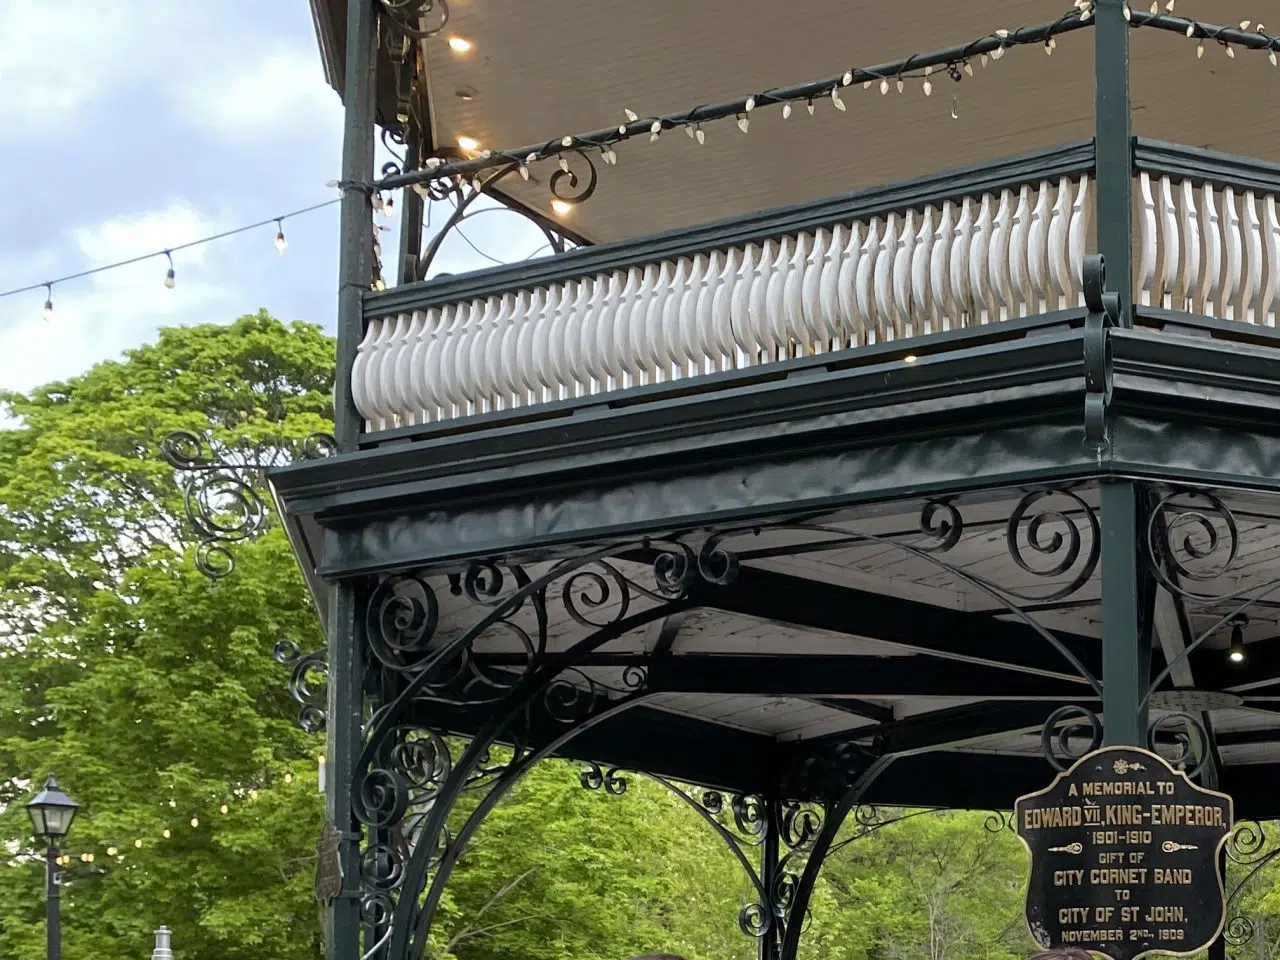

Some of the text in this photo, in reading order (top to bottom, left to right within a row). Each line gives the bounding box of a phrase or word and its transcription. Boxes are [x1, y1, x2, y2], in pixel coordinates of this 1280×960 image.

[1068, 781, 1175, 797] A MEMORIAL TO
[1024, 806, 1082, 830] EDWARD
[1092, 830, 1152, 845] 1901-1910
[1098, 852, 1145, 864] GIFT OF
[1053, 868, 1192, 887] CITY CORNET BAND
[1114, 889, 1131, 901] TO
[1058, 906, 1188, 924] CITY OF ST JOHN,
[1061, 929, 1124, 942] NOVEMBER
[1158, 929, 1185, 941] 1909
